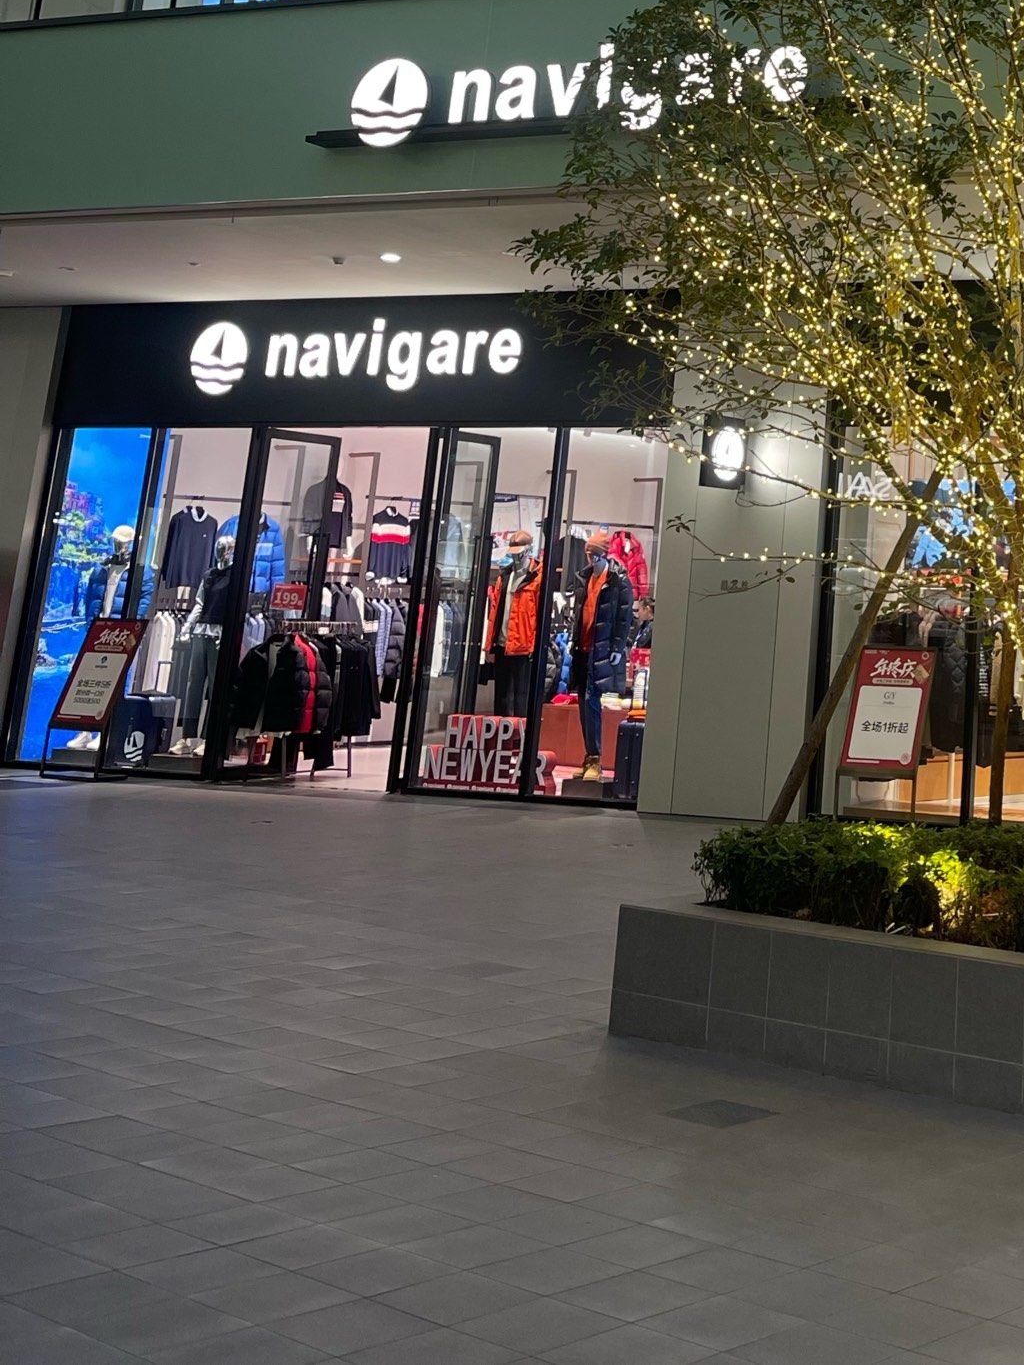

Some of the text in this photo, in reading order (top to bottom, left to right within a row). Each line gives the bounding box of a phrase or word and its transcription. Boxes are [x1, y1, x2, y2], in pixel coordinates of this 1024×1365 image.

[264, 318, 522, 392] navigare
[861, 719, 909, 734] 全场1折起
